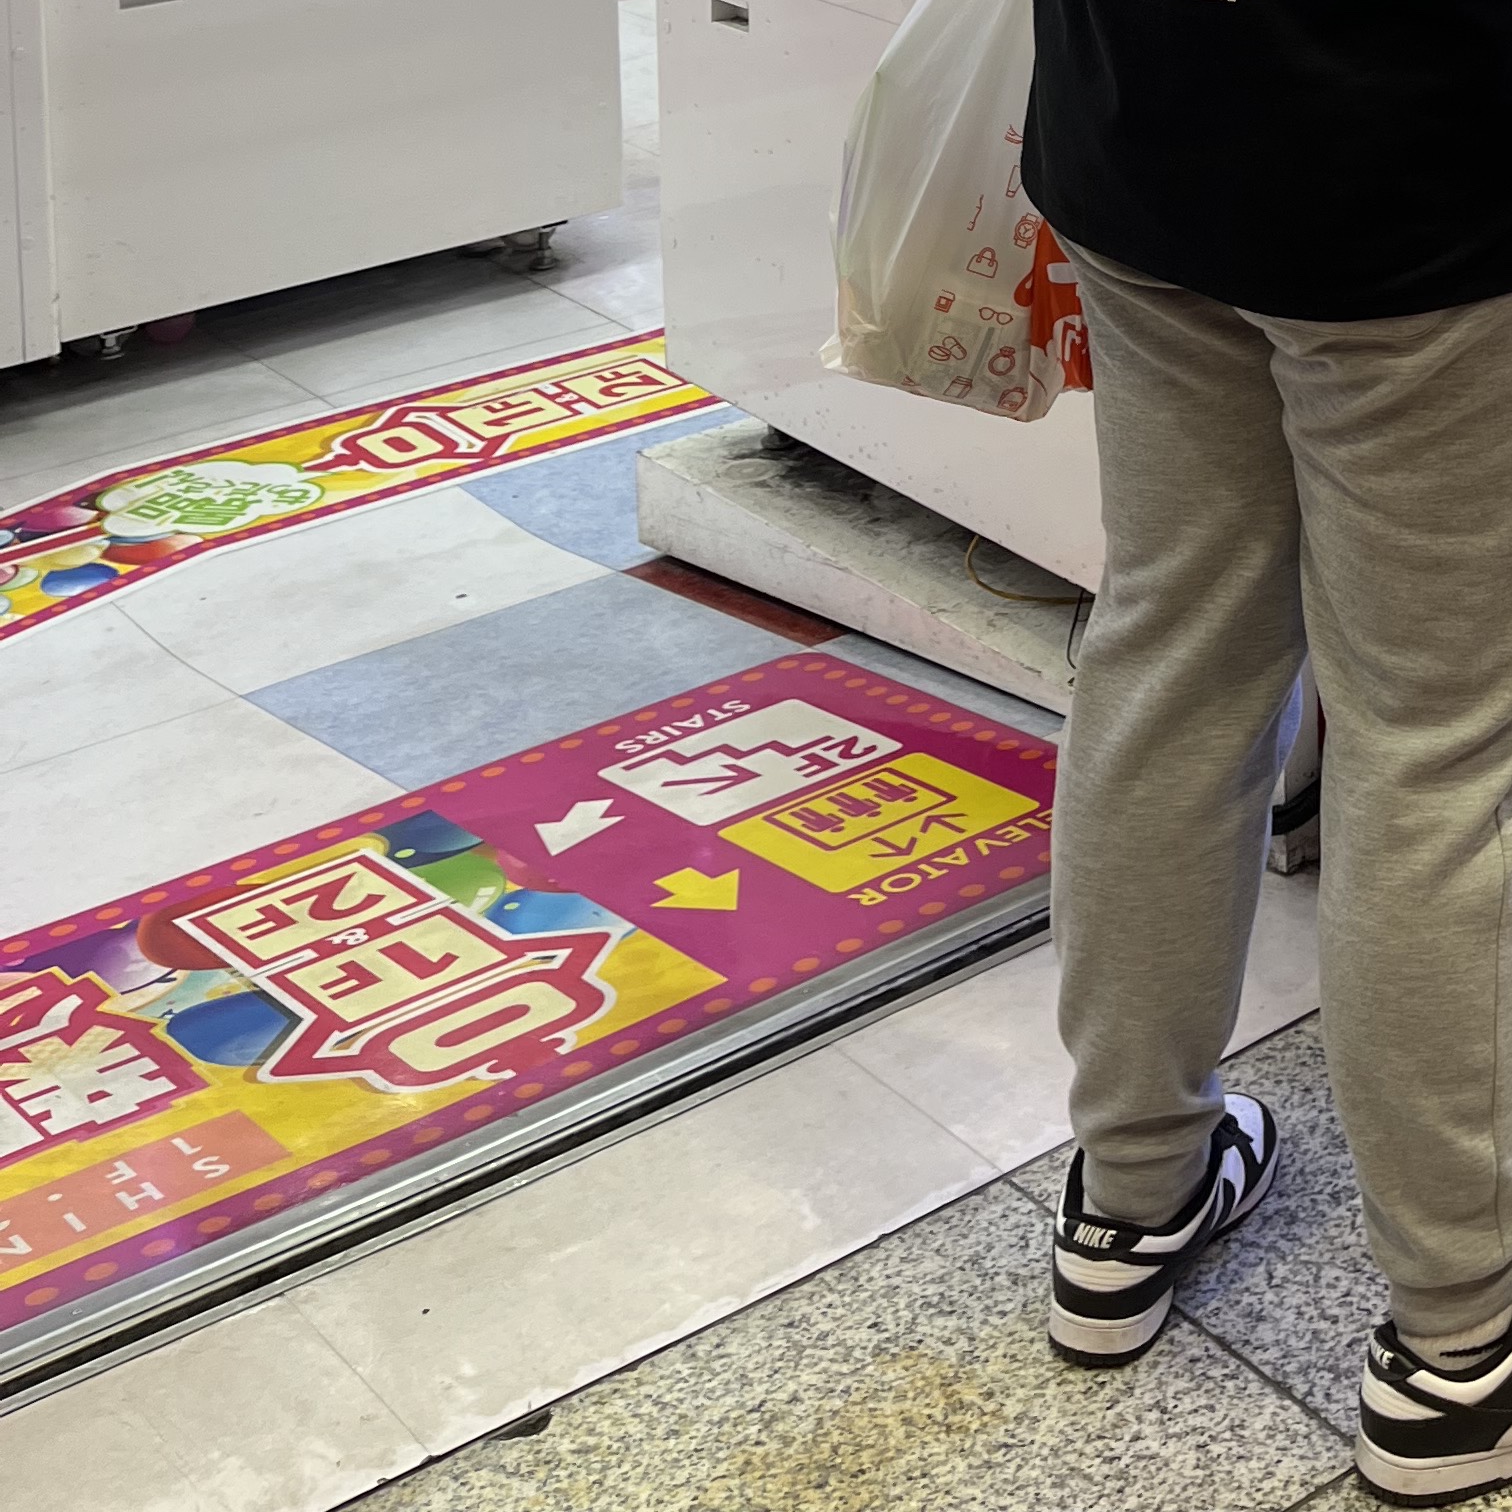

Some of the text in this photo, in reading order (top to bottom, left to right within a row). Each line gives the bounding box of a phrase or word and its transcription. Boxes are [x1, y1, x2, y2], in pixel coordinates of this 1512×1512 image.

[594, 369, 668, 399] 2F
[614, 699, 752, 756] STAIRS
[791, 734, 880, 780] 2F
[237, 871, 388, 941] 2F
[318, 939, 461, 1001] 1F
[1072, 1221, 1119, 1249] NIKE
